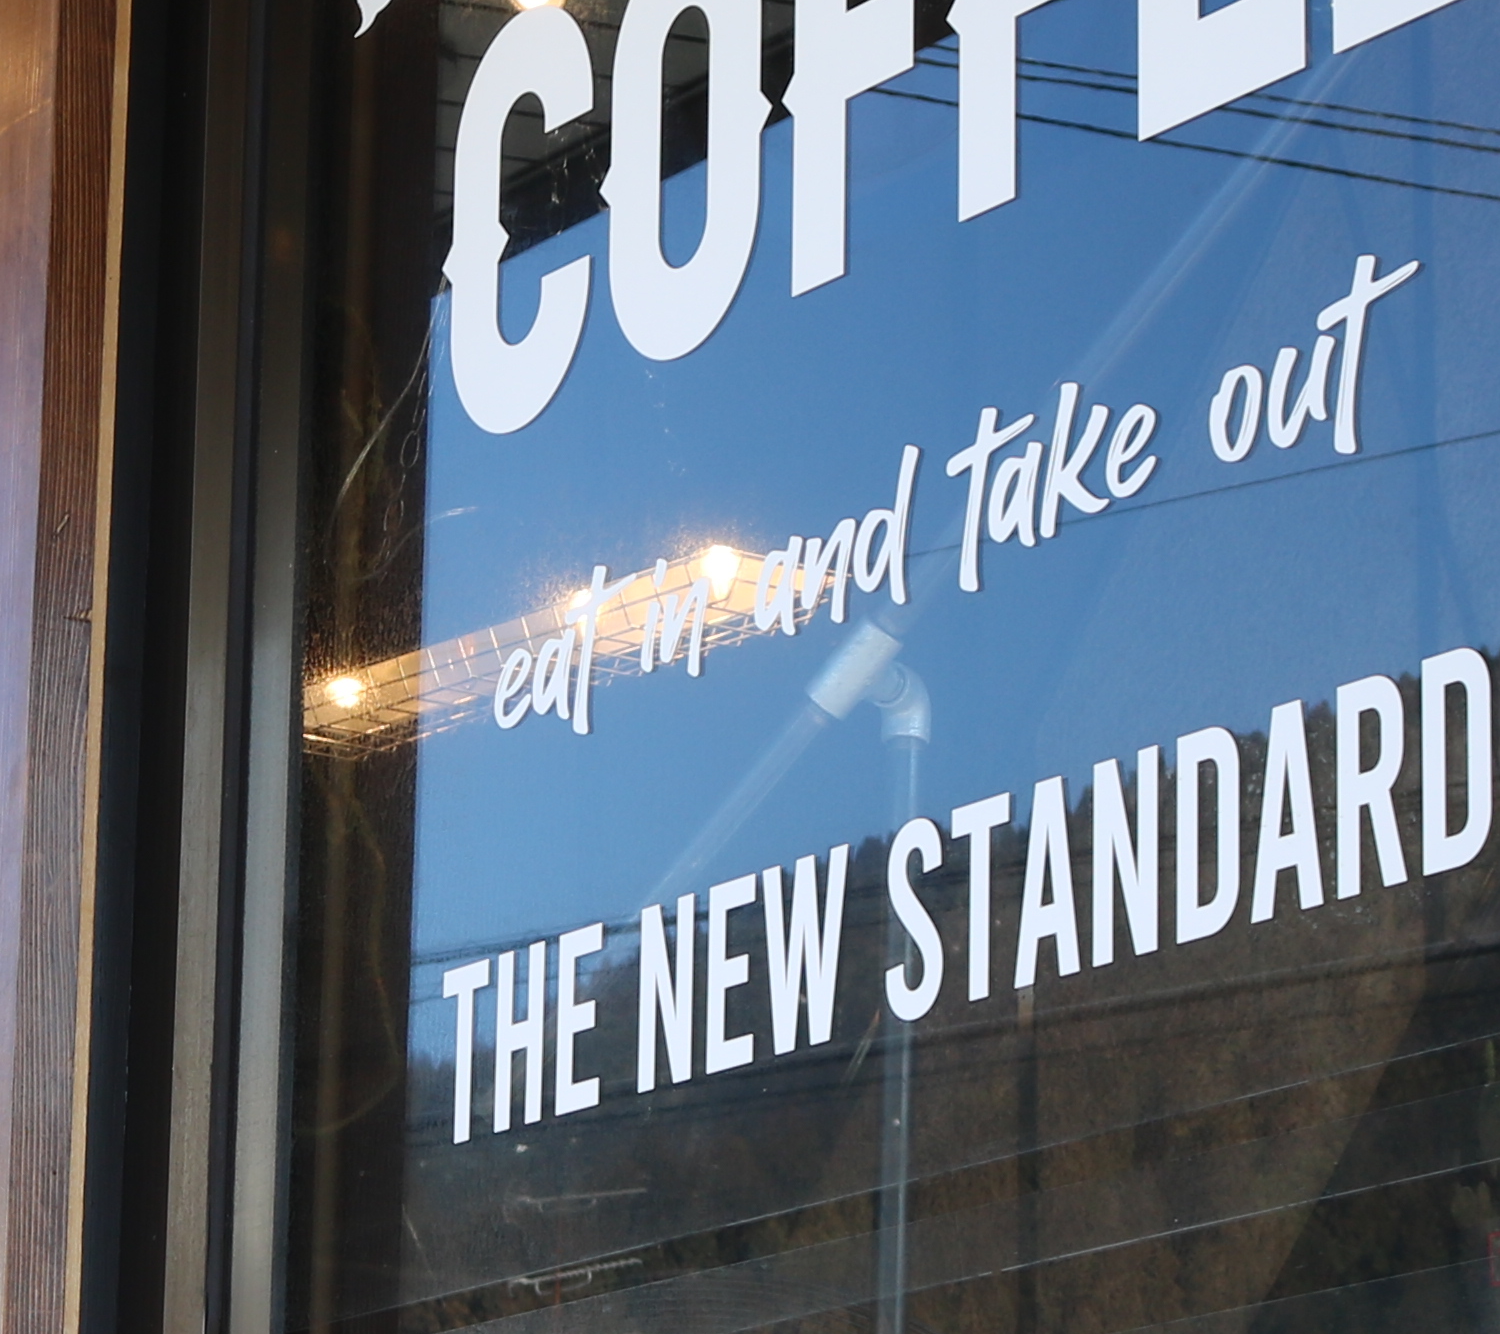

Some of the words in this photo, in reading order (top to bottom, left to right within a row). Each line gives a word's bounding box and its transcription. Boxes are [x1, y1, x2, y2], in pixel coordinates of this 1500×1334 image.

[493, 565, 638, 736] eat
[641, 557, 711, 677] in
[754, 444, 920, 636] and
[946, 381, 1160, 593] take
[1207, 254, 1422, 463] out
[442, 921, 604, 1146] THE
[636, 844, 851, 1094] NEW
[884, 646, 1495, 1023] STANDARD
